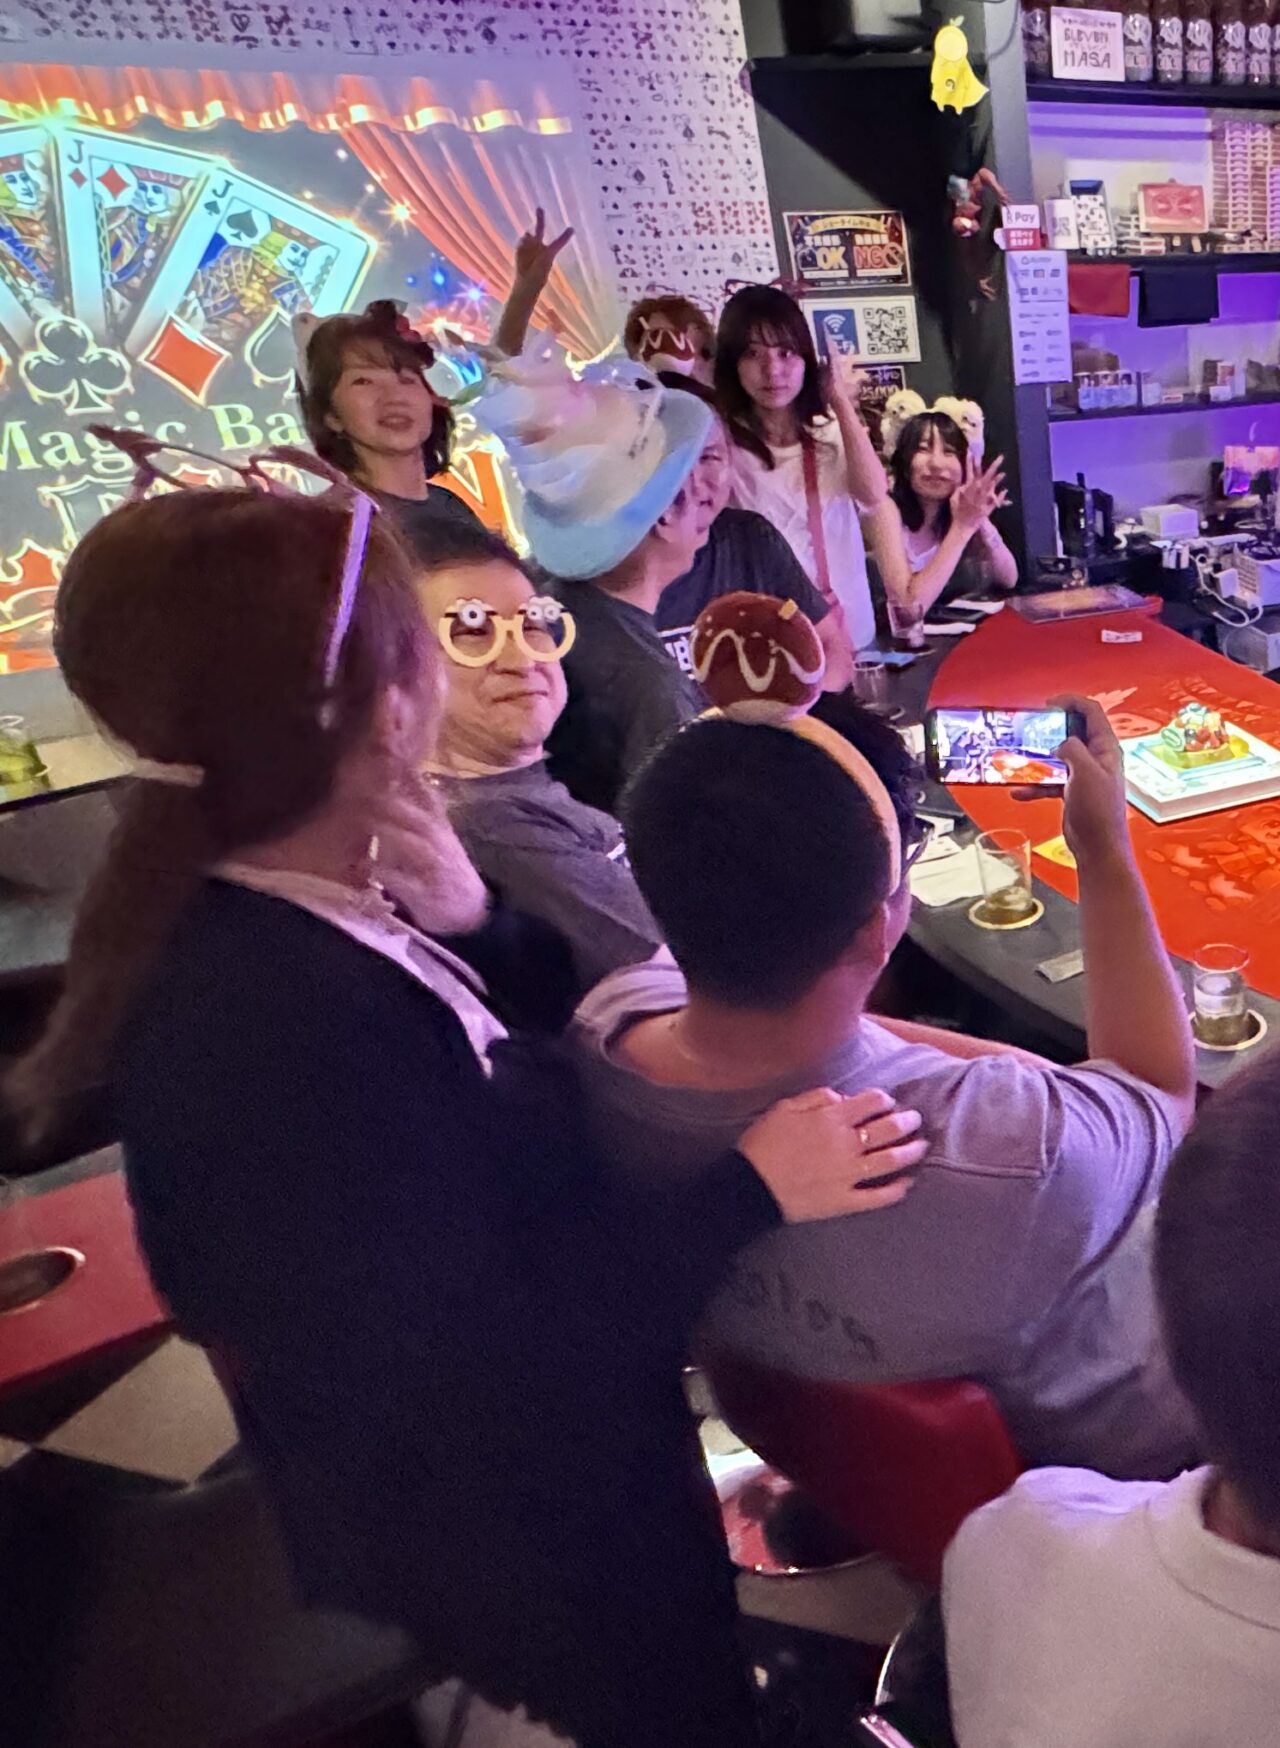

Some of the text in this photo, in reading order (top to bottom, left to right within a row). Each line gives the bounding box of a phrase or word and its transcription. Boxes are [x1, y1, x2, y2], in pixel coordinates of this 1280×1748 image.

[1063, 51, 1111, 69] MASA
[1015, 211, 1036, 224] Pay
[817, 245, 887, 270] OK NG
[207, 403, 306, 451] Ba
